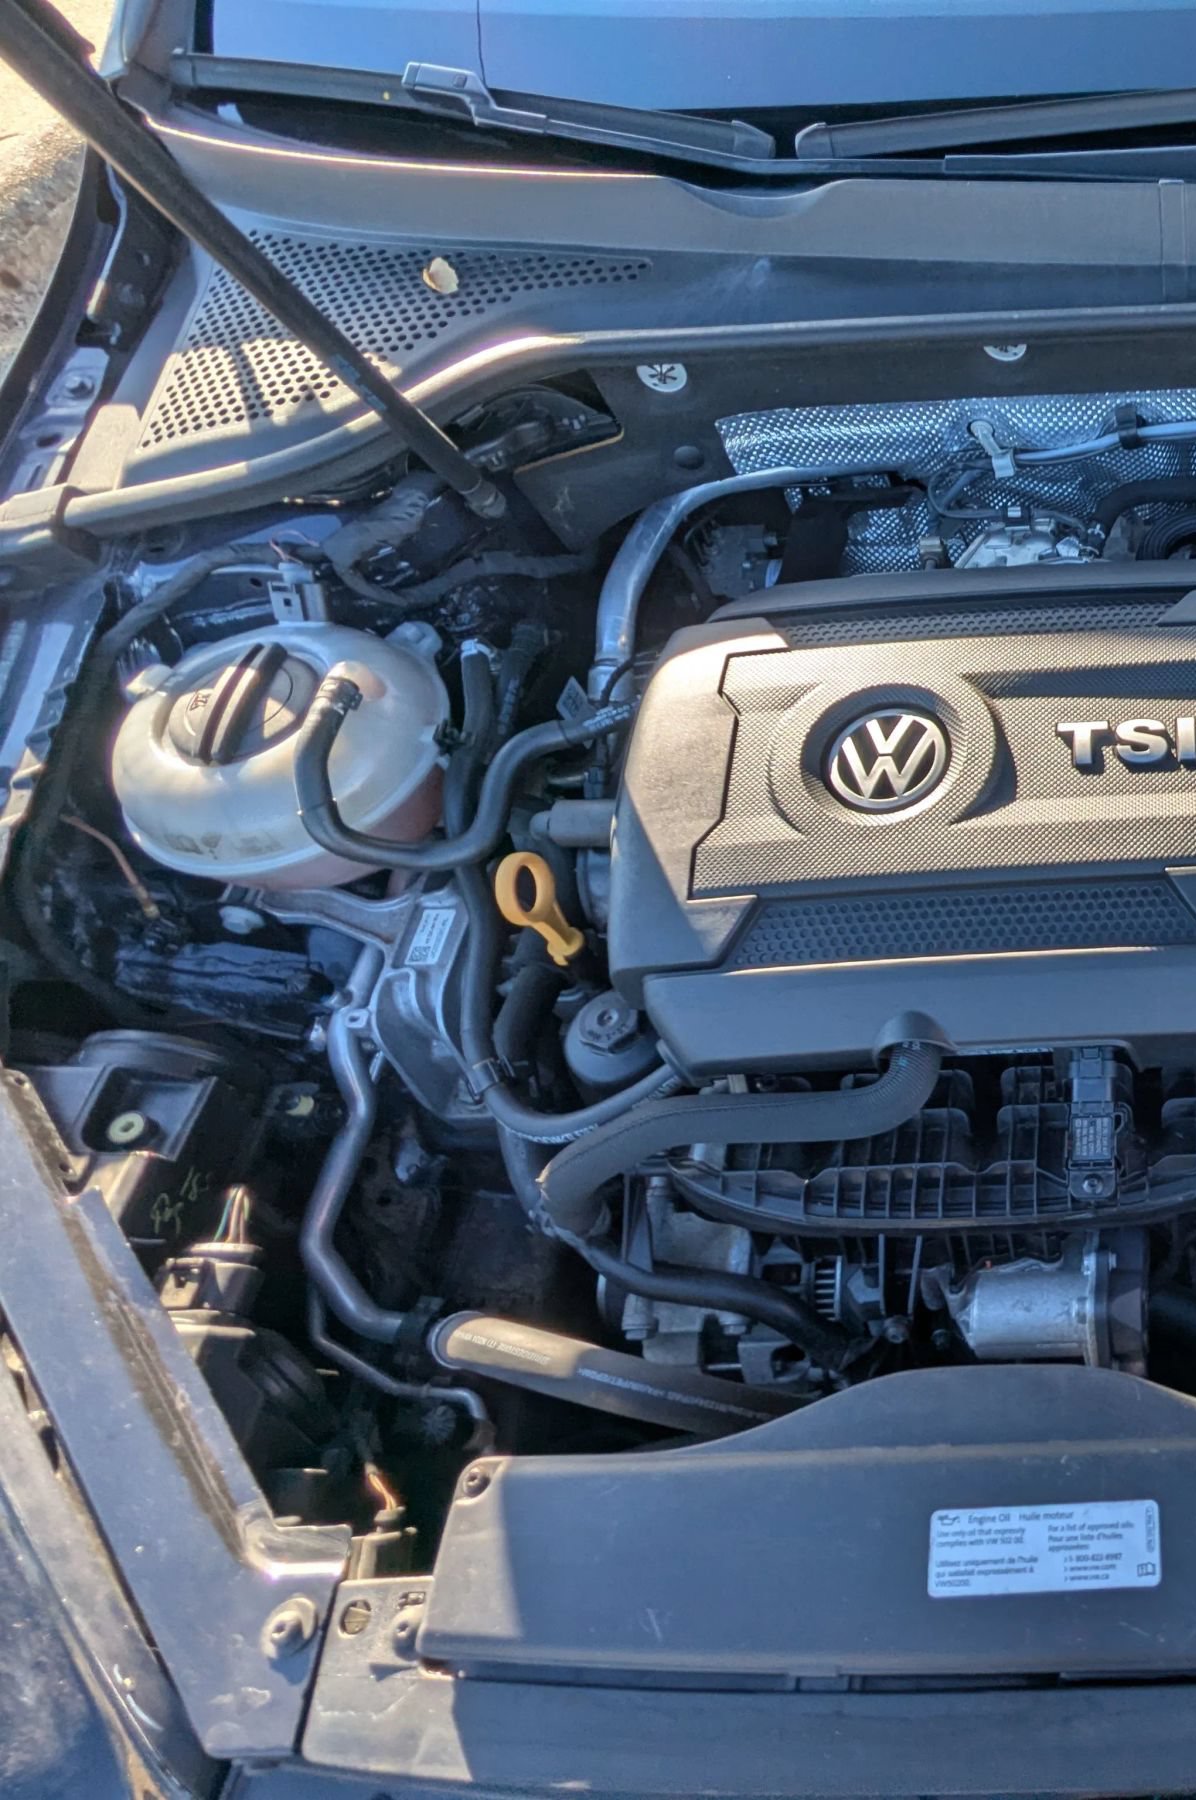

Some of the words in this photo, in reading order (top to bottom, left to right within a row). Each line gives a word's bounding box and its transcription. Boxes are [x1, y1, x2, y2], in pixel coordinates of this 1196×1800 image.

[968, 1515, 996, 1525] Engine
[999, 1513, 1010, 1521] Oil
[1019, 1513, 1040, 1521] Huile
[1043, 1511, 1074, 1519] moteur
